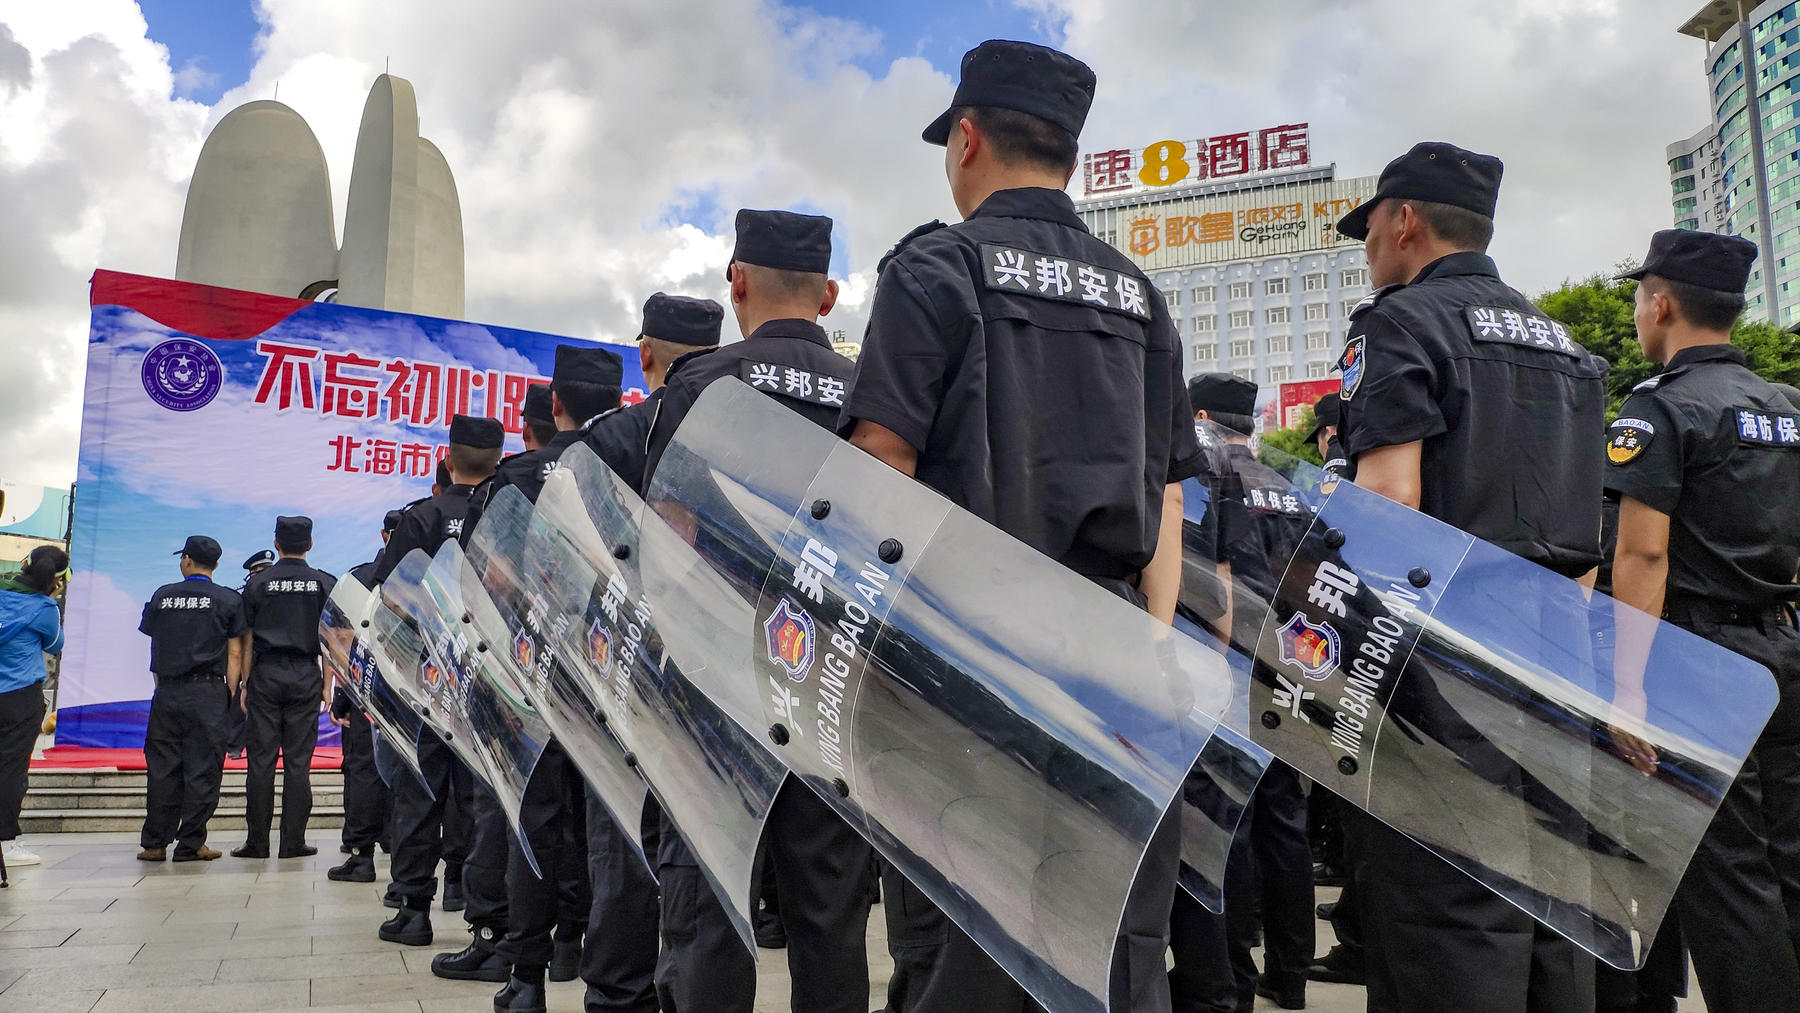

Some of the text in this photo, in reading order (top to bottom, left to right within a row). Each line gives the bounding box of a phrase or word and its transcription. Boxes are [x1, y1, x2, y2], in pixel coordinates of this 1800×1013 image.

[1084, 123, 1309, 196] 速8酒店
[1166, 211, 1234, 247] 歌皇
[1314, 197, 1360, 218] KTV
[993, 249, 1146, 316] 兴邦安保
[1473, 308, 1576, 352] 兴邦安保
[750, 363, 845, 406] 兴邦安
[1614, 435, 1638, 447] 保安
[1739, 410, 1800, 442] 海防保
[1243, 489, 1299, 513] 防保安
[161, 597, 211, 609] 兴邦保安
[268, 580, 318, 592] 兴邦安保
[1307, 560, 1360, 619] 邦
[620, 623, 643, 666] BAO
[816, 561, 890, 778] XING BANG BAO AN
[1331, 583, 1421, 759] XING BANG BAO AN
